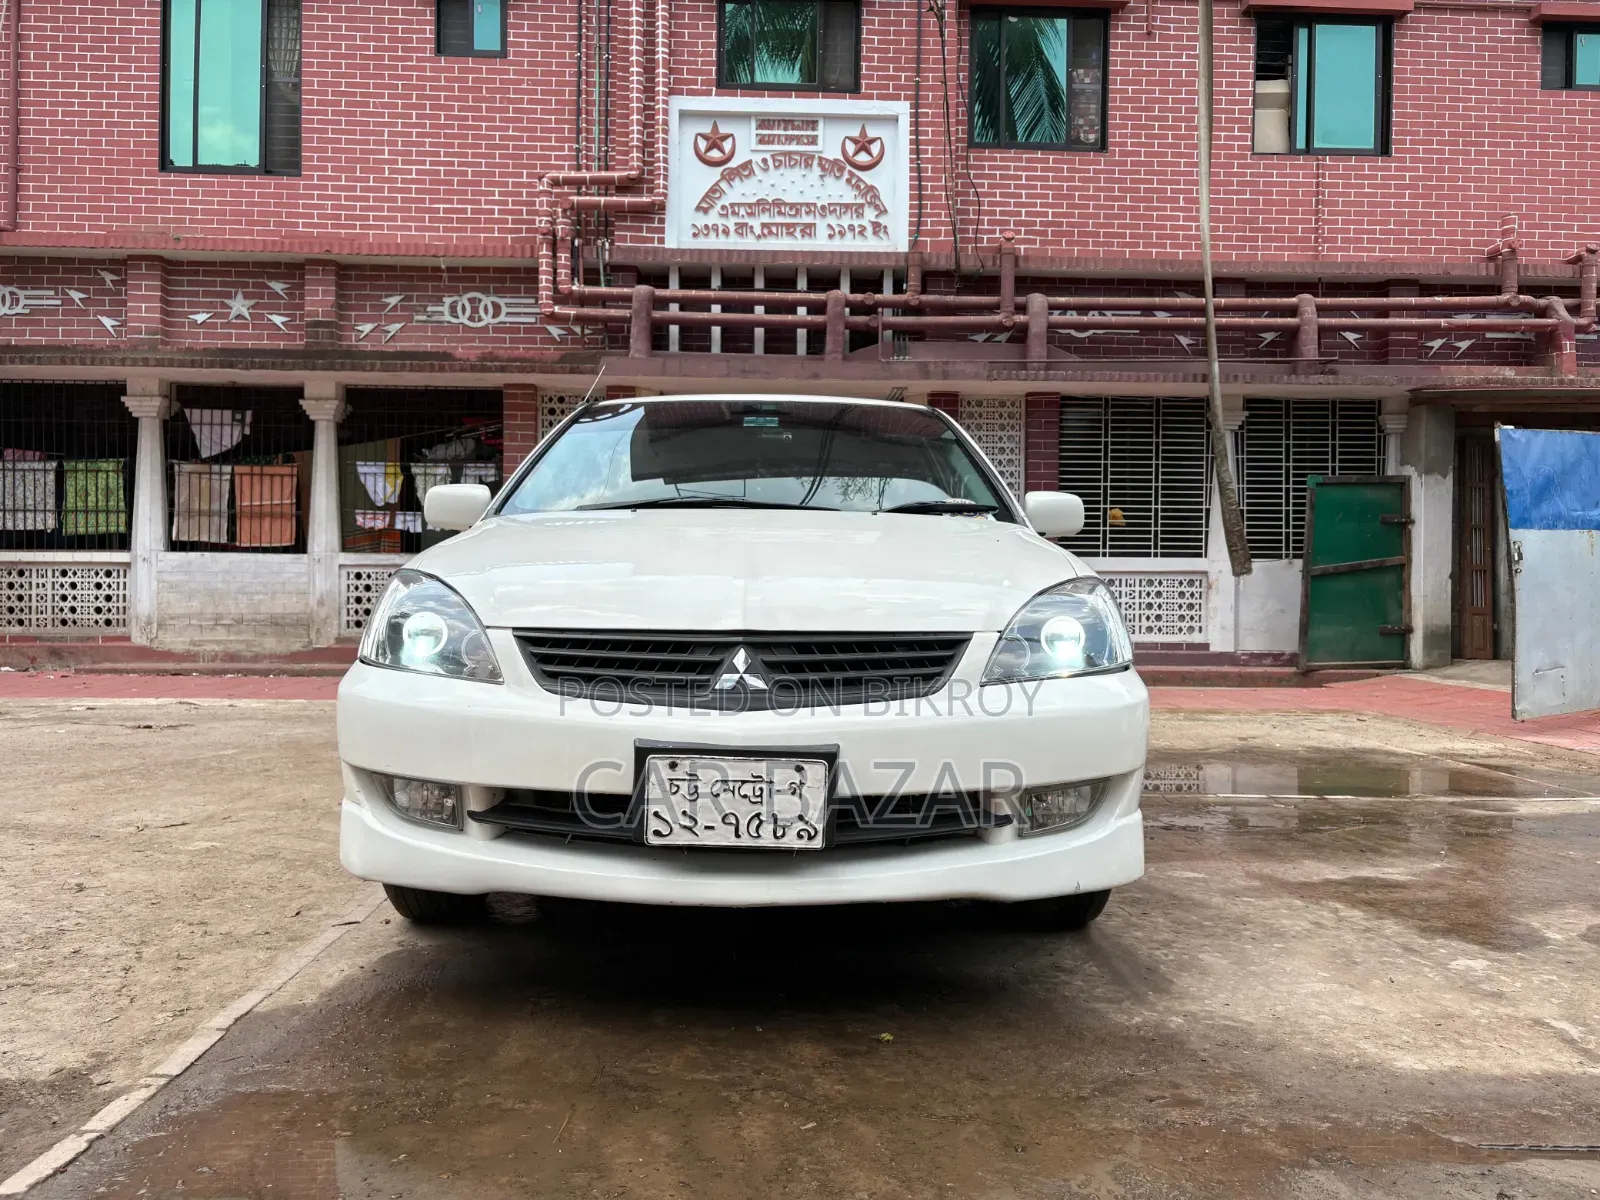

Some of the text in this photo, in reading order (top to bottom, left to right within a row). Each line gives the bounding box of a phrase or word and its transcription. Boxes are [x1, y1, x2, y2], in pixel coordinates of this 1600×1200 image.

[694, 177, 727, 214] মাতা
[755, 157, 769, 171] ও
[770, 151, 816, 170] চাচার
[691, 222, 731, 239] ১৩৭৯
[826, 222, 868, 240] ১৯৭২
[652, 809, 818, 841] ১২-৭৫৮৯
